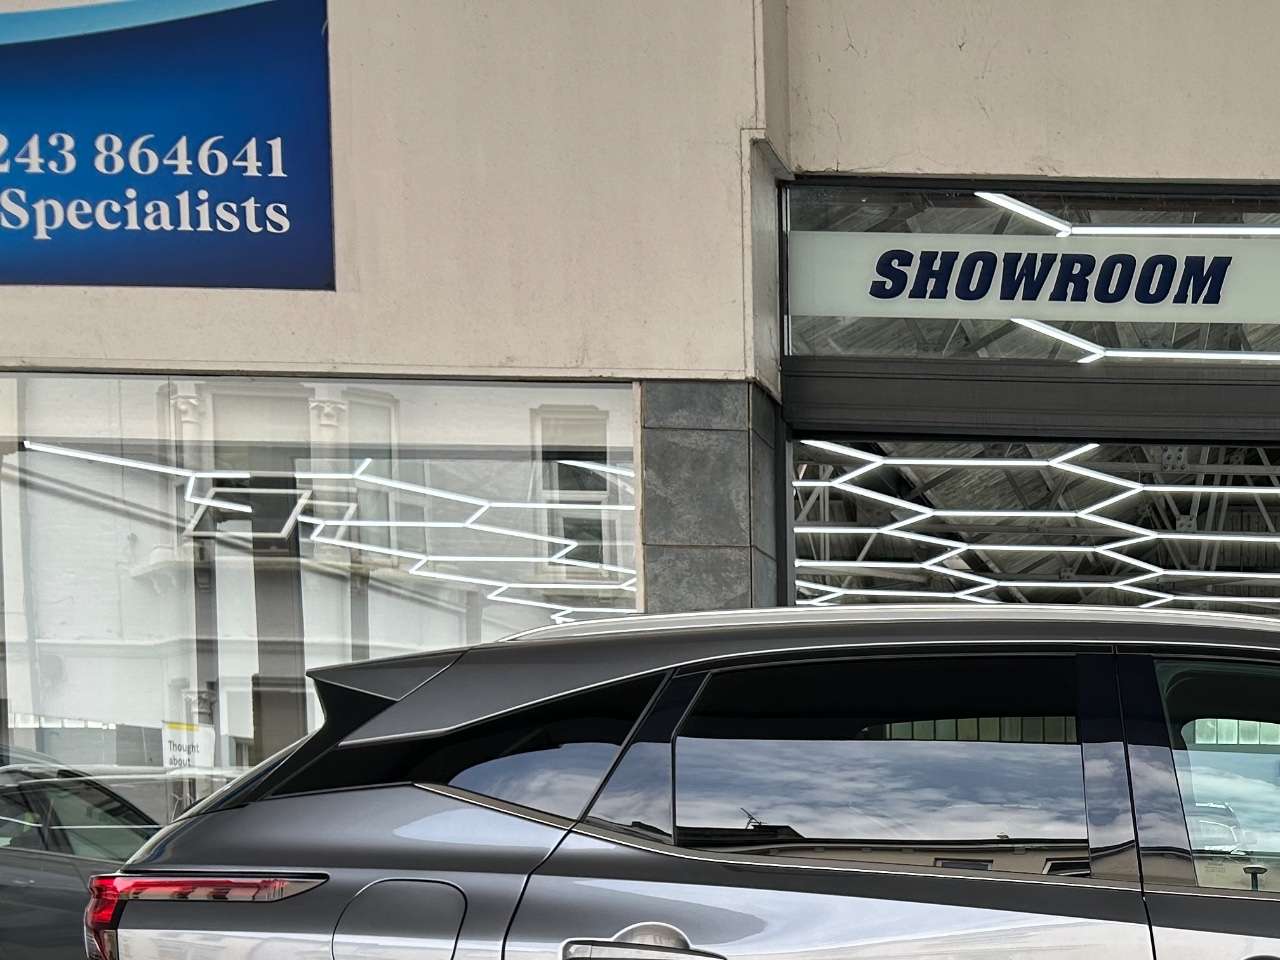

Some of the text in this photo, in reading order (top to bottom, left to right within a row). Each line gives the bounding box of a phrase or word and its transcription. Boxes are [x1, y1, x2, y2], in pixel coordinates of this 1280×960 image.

[94, 133, 288, 177] 864641
[0, 188, 290, 241] Specialists
[869, 249, 1233, 305] SHOWROOM
[168, 740, 200, 755] Thought
[169, 755, 191, 767] about
